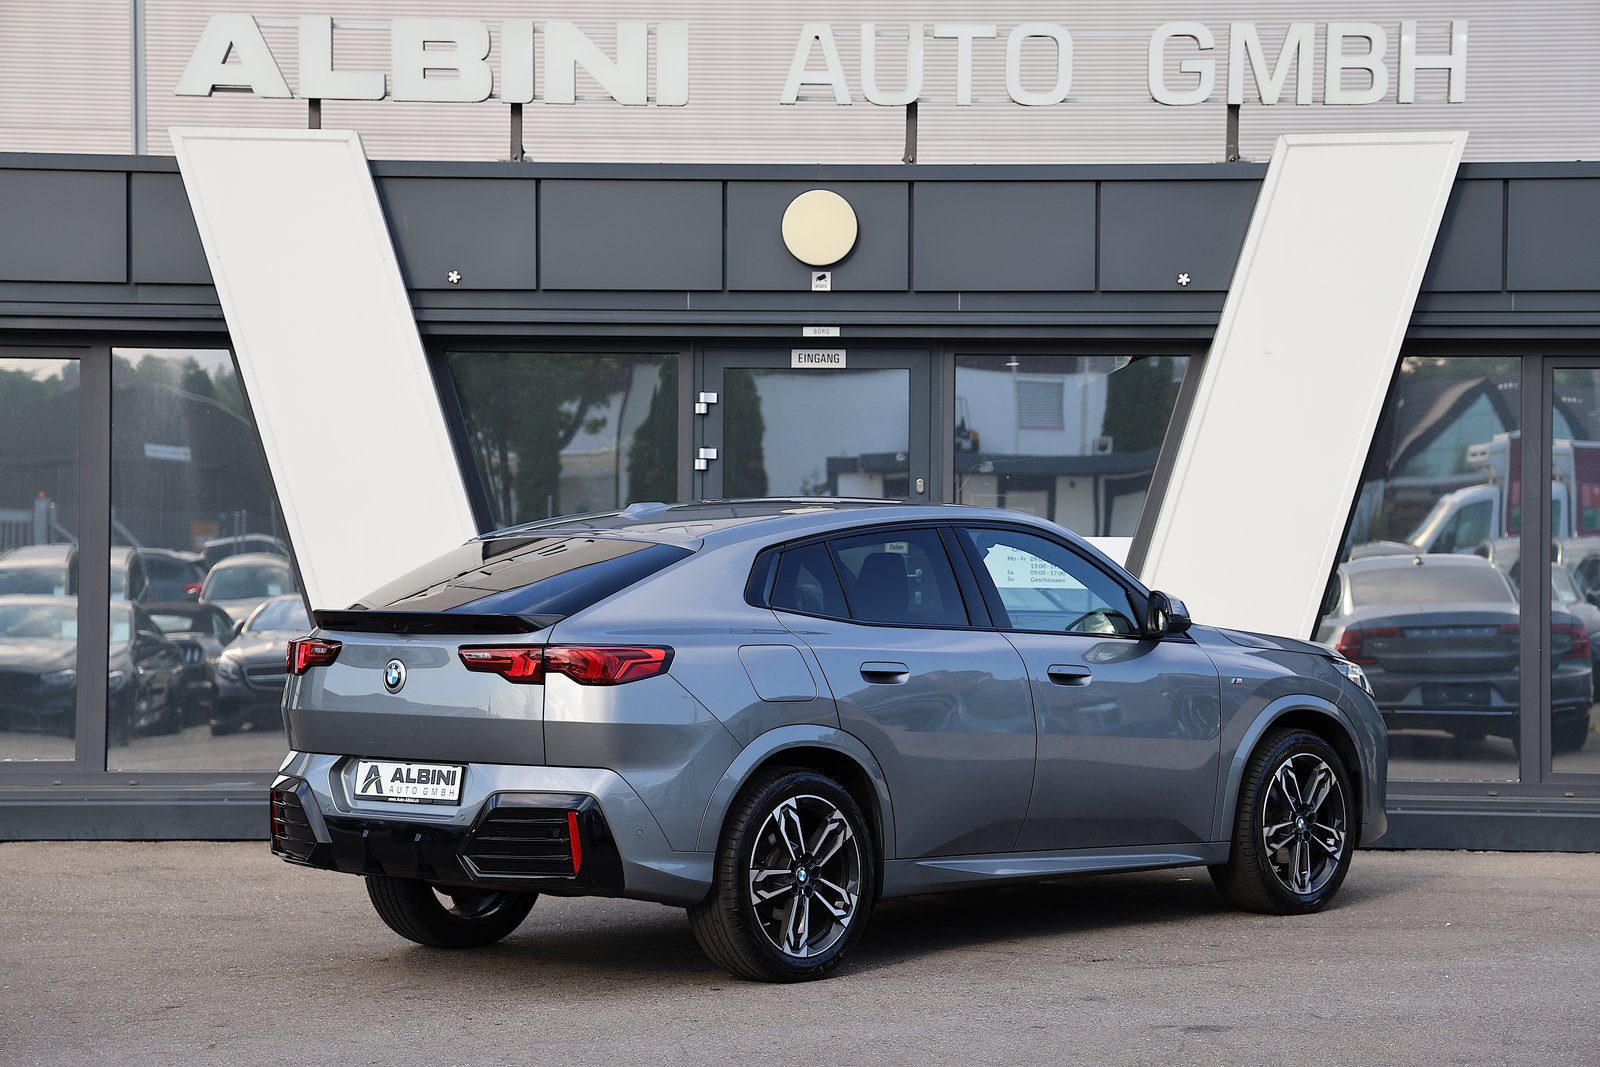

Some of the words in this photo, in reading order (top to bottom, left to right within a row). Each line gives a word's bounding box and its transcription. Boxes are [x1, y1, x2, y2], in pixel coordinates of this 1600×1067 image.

[173, 13, 690, 107] ALBINI
[780, 22, 1074, 107] AUTO
[1146, 19, 1469, 107] GMBH
[798, 353, 840, 364] EINGANG
[390, 767, 457, 786] ALBINI
[389, 785, 418, 795] AUTO
[423, 787, 455, 797] GMBH
